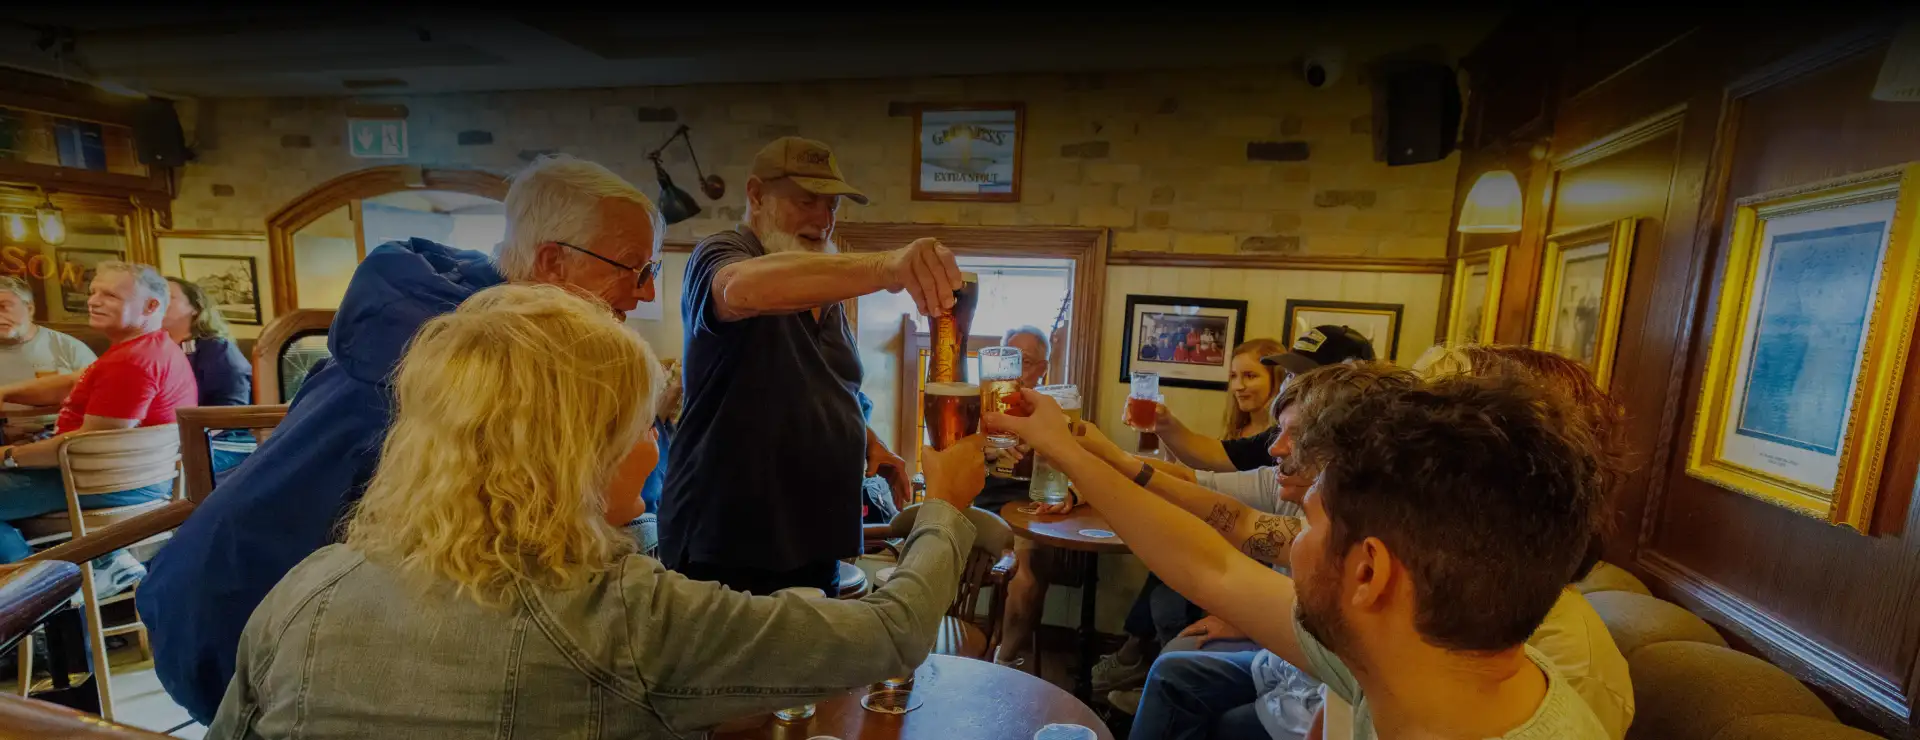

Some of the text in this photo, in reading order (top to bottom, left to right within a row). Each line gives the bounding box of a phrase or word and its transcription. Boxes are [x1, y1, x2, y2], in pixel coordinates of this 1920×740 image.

[932, 124, 1005, 146] GUINESS
[934, 171, 999, 183] EXTRA STOUT
